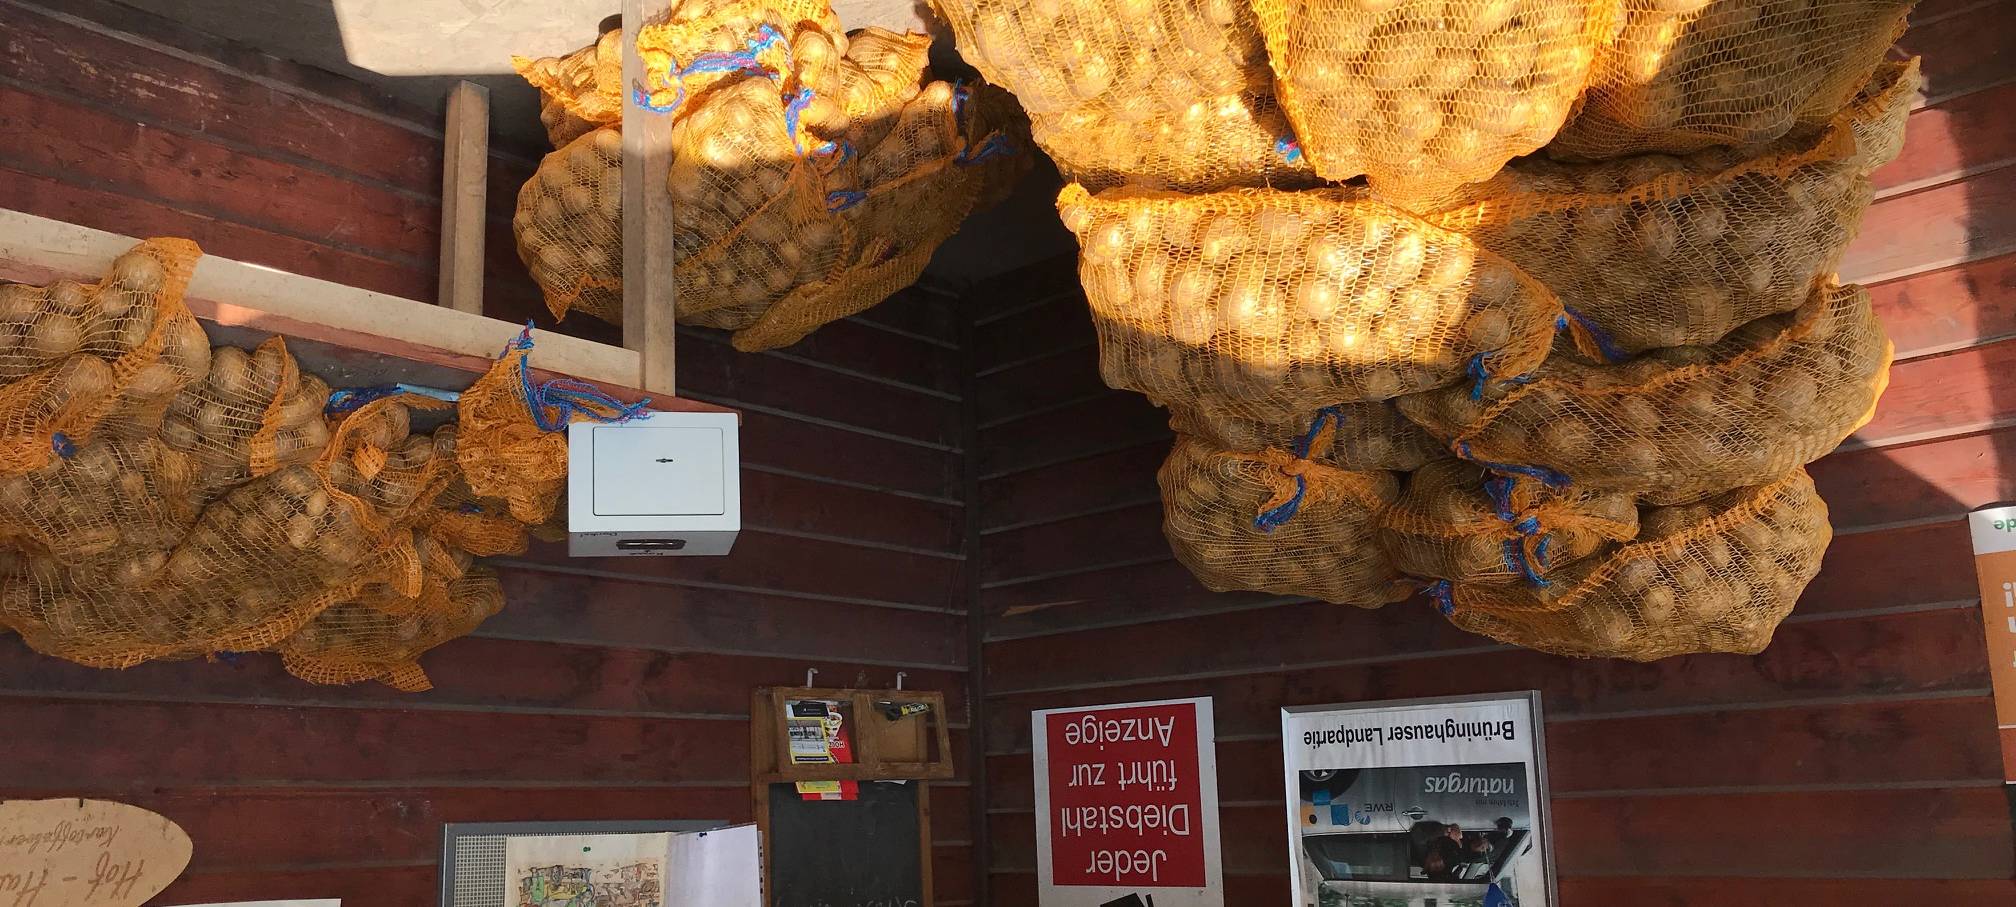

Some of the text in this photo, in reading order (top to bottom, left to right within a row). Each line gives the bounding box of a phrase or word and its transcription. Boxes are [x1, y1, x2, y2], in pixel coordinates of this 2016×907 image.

[1065, 714, 1175, 751] Anzeige
[1303, 718, 1515, 750] Brüninghauser Landpartie
[1068, 759, 1178, 792] führt zur
[1424, 772, 1515, 797] naturgas
[1061, 804, 1190, 837] Diebstahl
[1364, 802, 1394, 813] RWE
[84, 851, 145, 902] Hof
[1085, 849, 1167, 882] Jeder
